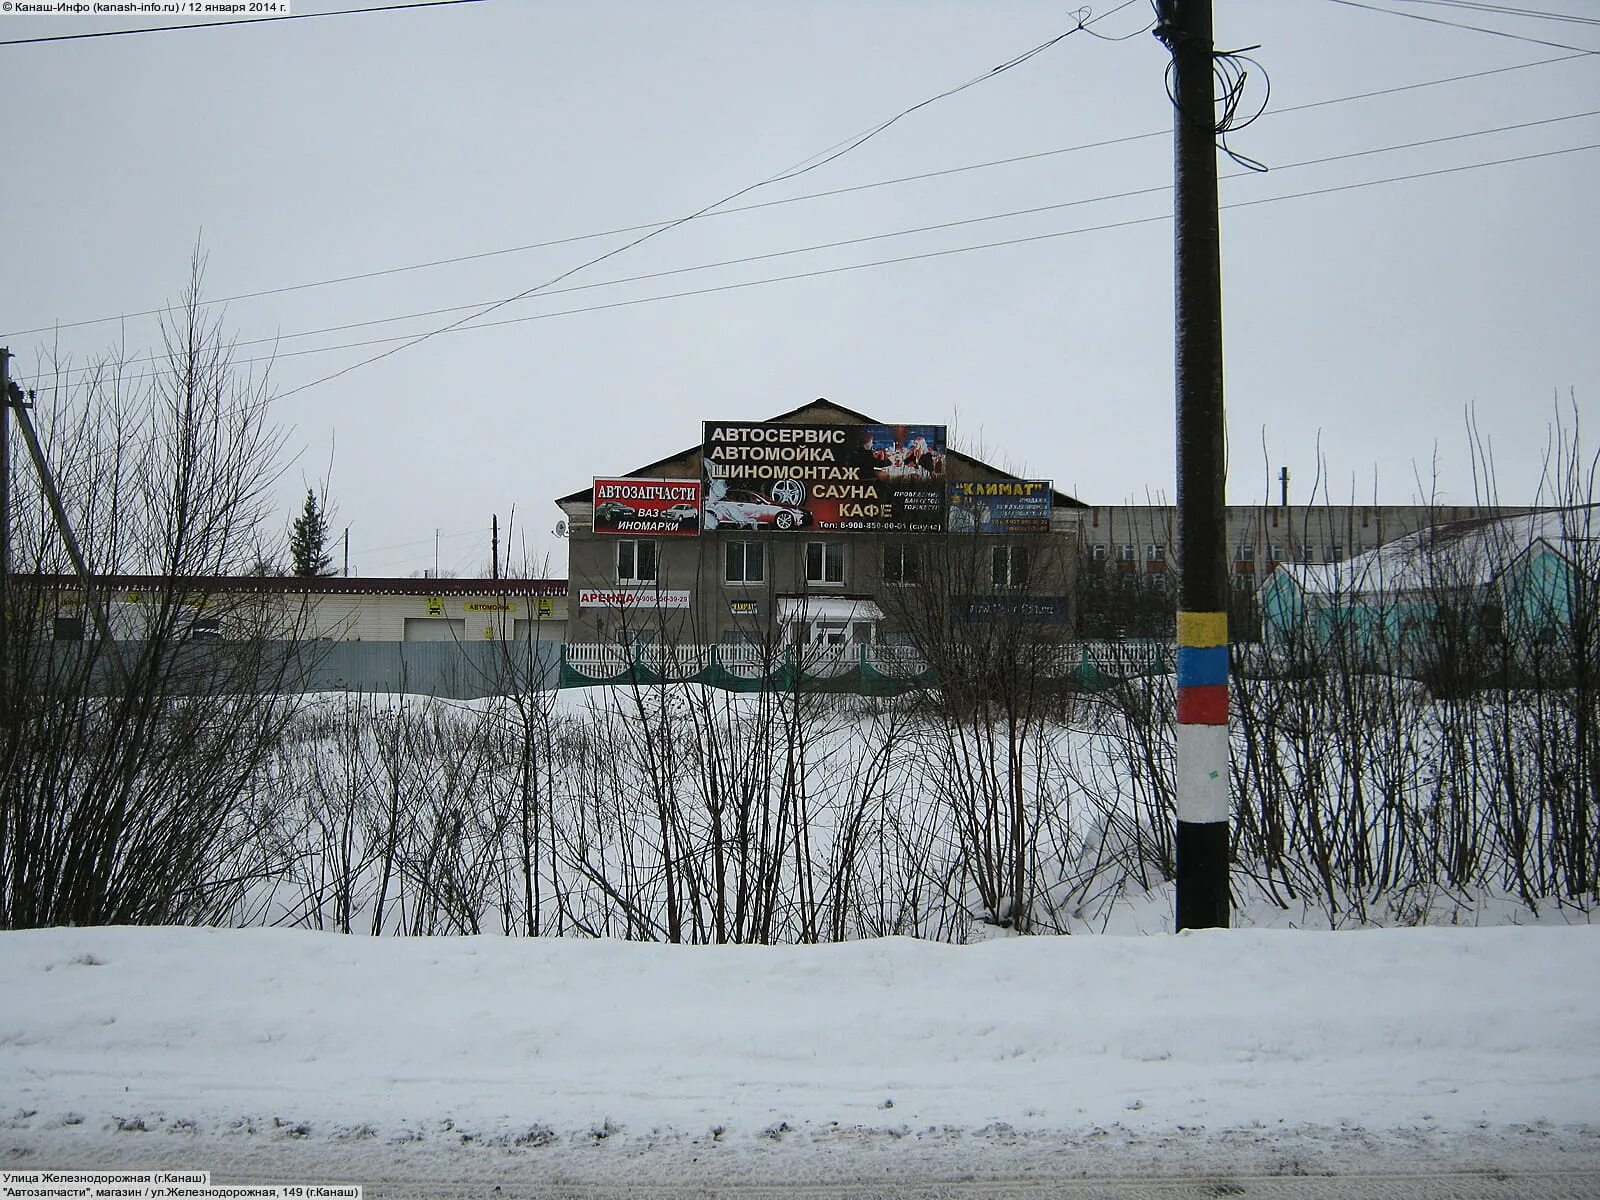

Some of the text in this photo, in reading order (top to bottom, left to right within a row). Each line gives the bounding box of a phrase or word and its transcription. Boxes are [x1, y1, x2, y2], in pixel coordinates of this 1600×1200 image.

[711, 427, 846, 444] АВТОСЕРВИС
[710, 445, 836, 462] АВТОМОЙКА
[711, 464, 860, 480] ШИНОМОНТАЖ
[597, 485, 696, 501] АВТОЗАПЧАСТИ
[811, 484, 879, 499] САУНА
[637, 508, 660, 518] ВАЗ
[839, 503, 893, 518] КАФЕ
[617, 520, 679, 532] ИНОМАРКИ
[581, 593, 635, 605] АРЕНДА
